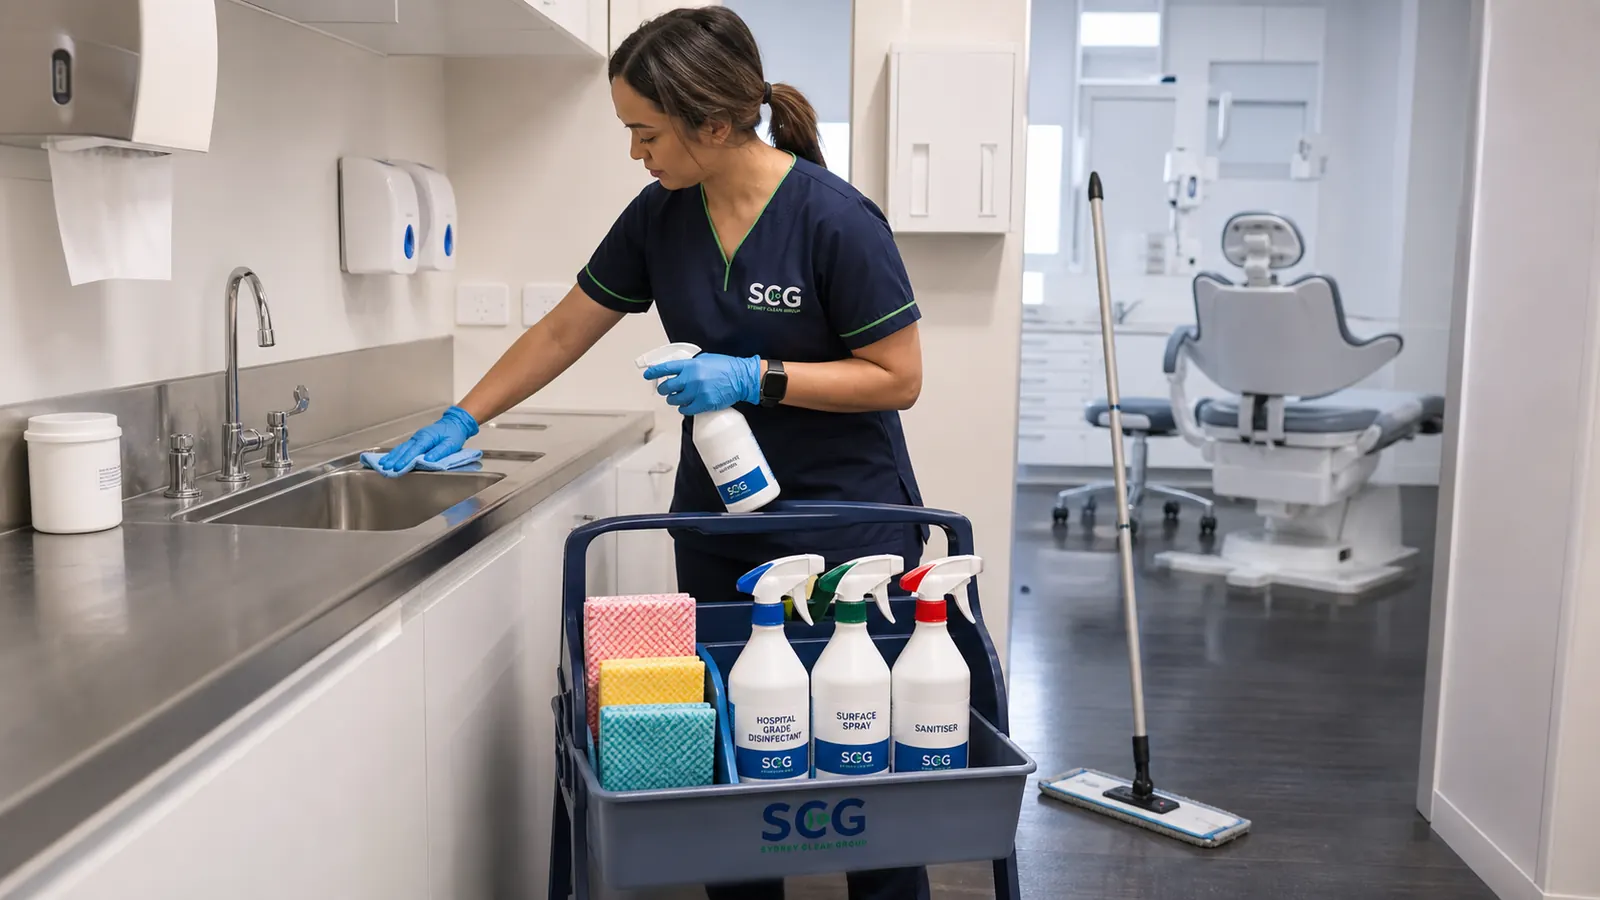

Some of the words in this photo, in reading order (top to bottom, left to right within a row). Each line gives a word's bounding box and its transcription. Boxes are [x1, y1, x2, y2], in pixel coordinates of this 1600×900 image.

[748, 282, 802, 308] SCG
[756, 715, 796, 725] HOSPITAL
[836, 711, 877, 721] SURFACE
[762, 724, 792, 734] GRADE
[842, 721, 872, 731] SPRAY
[914, 723, 959, 733] SANITISER
[748, 732, 802, 743] DISINFECTANT
[761, 755, 792, 769] SCG
[841, 751, 873, 764] SCG
[921, 754, 951, 767] SCG
[761, 797, 866, 842] SCG
[760, 843, 799, 854] SYDNEY
